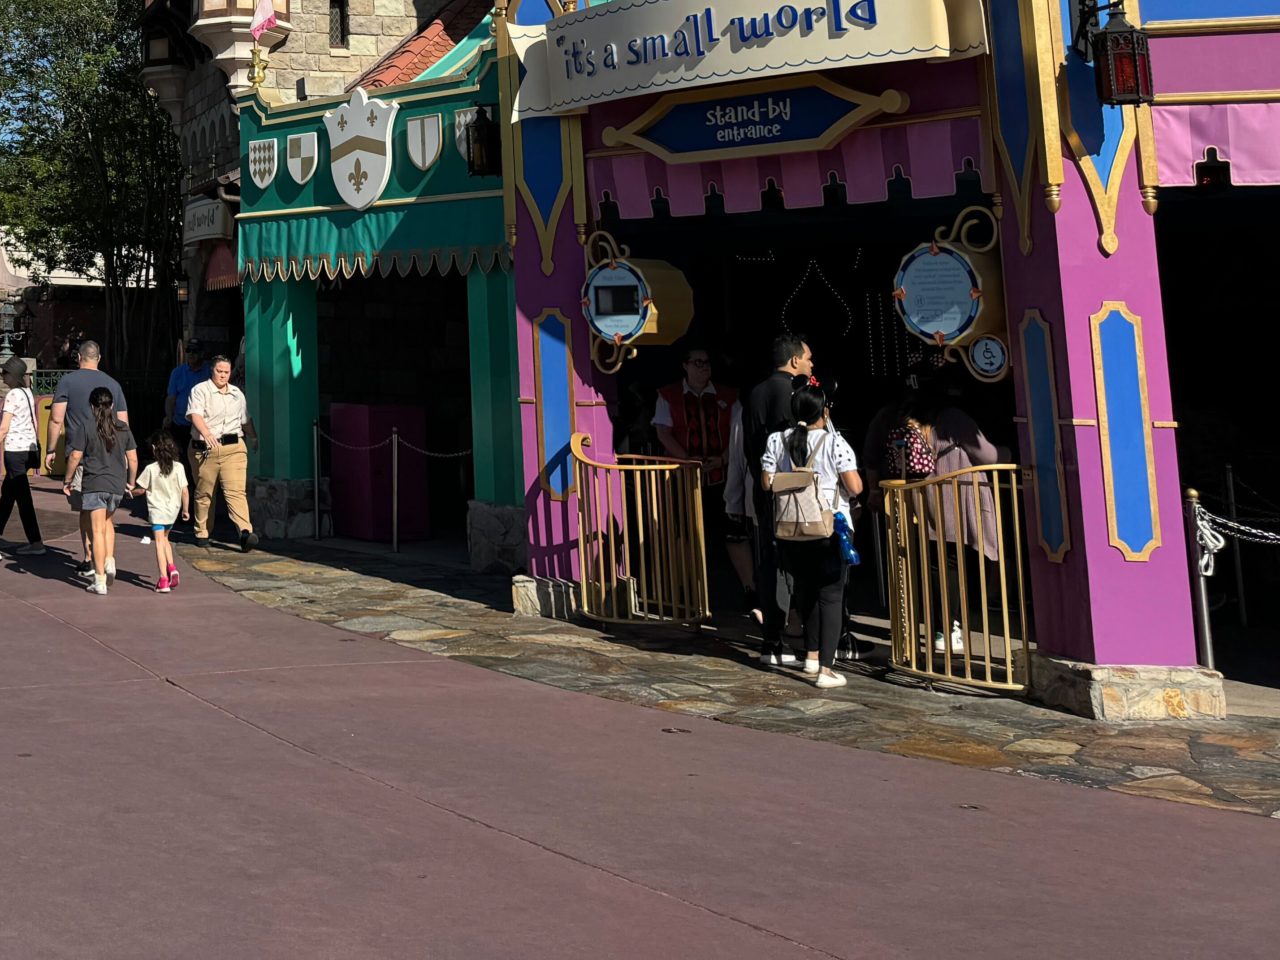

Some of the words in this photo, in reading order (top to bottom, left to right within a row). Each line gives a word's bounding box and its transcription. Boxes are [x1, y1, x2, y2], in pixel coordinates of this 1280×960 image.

[603, 43, 619, 70] a
[627, 7, 721, 66] small
[705, 97, 791, 126] stand-by
[716, 123, 782, 142] entrance
